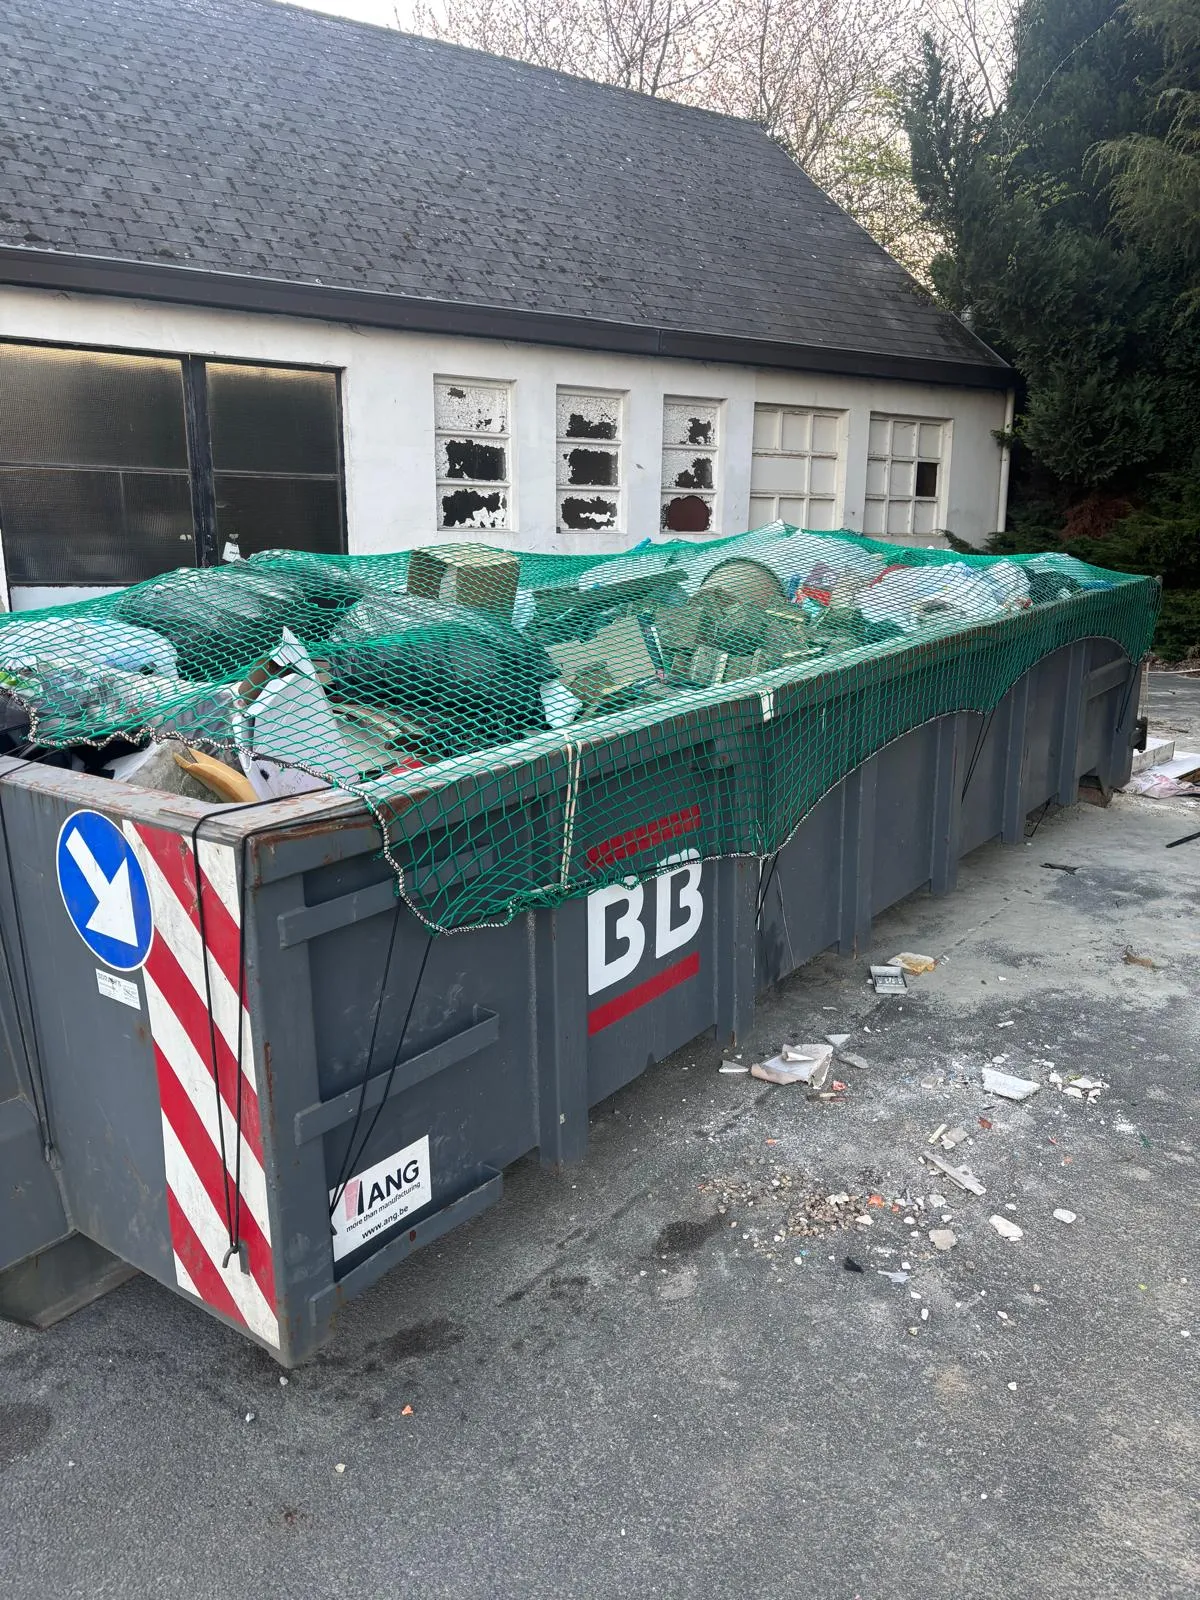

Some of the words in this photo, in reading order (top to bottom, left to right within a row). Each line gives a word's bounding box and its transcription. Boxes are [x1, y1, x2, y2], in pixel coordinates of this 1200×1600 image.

[588, 848, 704, 996] BB
[346, 1217, 363, 1233] more
[363, 1209, 378, 1222] than
[378, 1182, 421, 1213] manufacturing
[361, 1206, 409, 1239] www.ang.be
